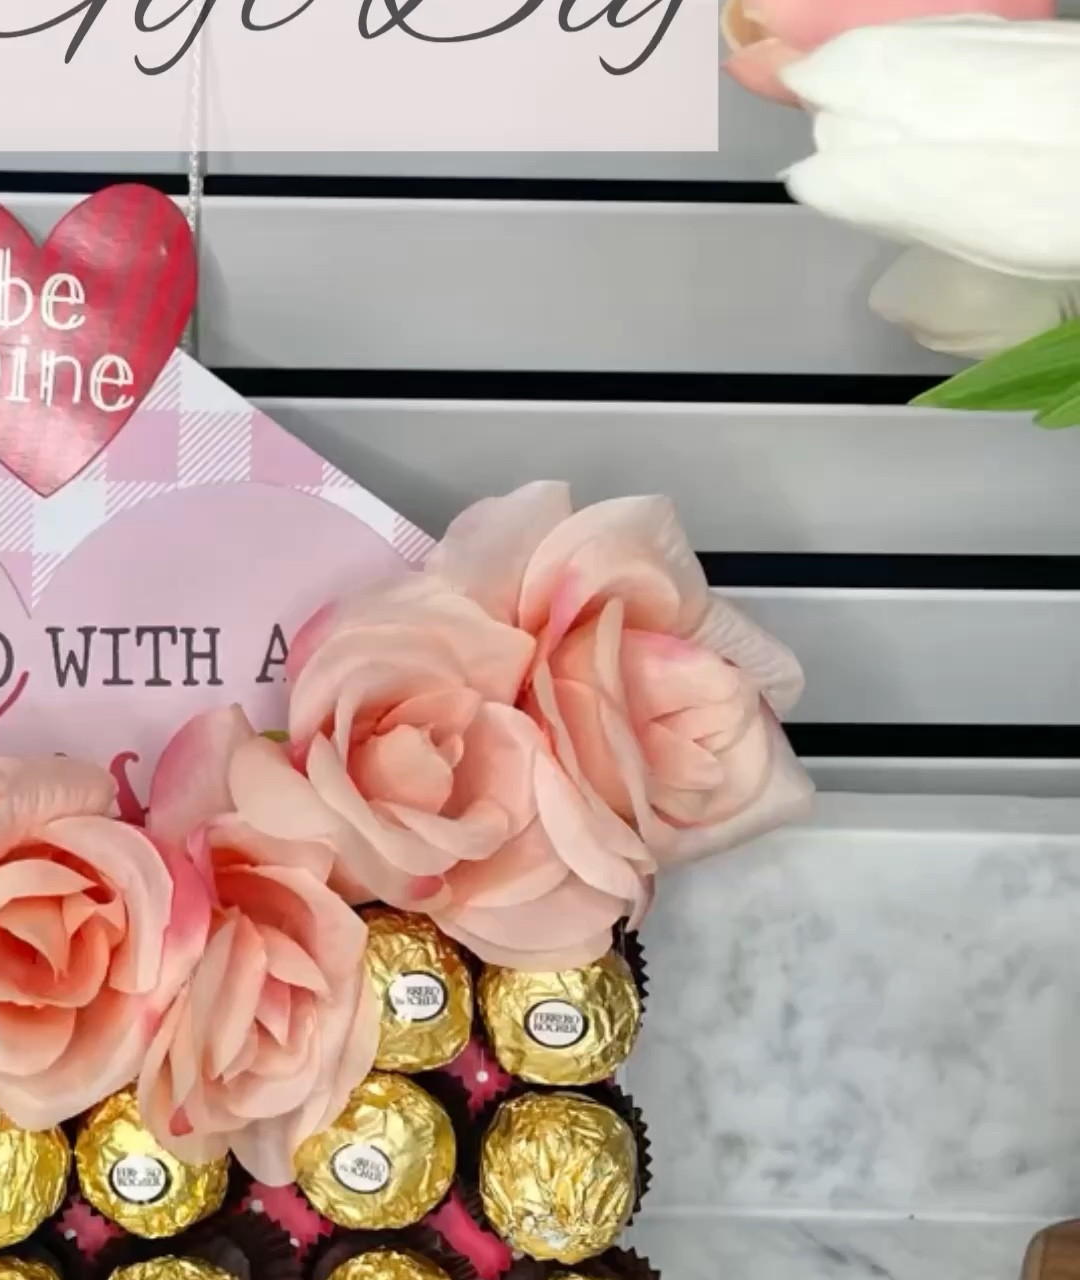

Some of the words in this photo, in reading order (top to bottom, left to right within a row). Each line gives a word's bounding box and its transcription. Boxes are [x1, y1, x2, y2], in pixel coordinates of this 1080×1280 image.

[45, 624, 224, 688] WITH
[532, 1012, 581, 1024] FERRERO
[533, 1023, 580, 1034] ROCHER
